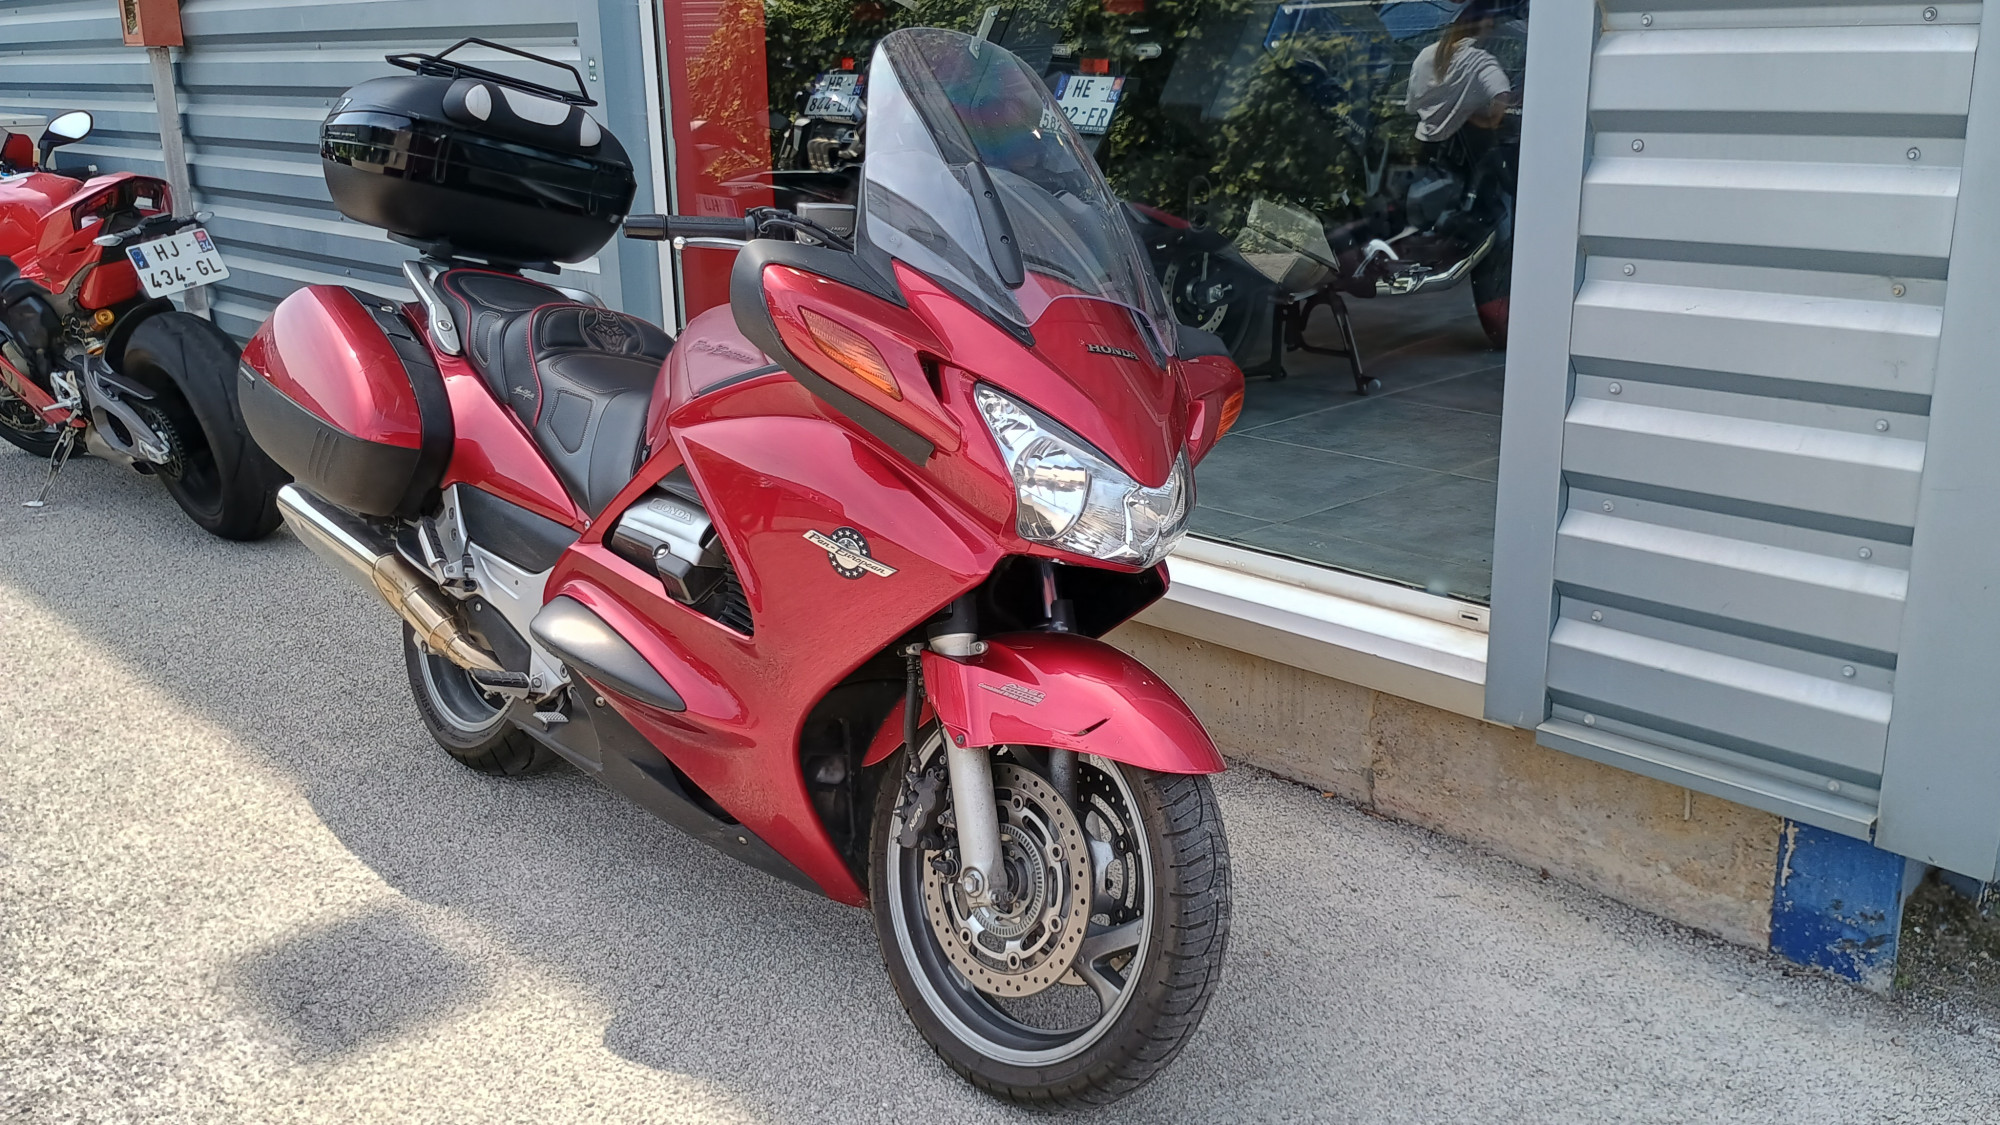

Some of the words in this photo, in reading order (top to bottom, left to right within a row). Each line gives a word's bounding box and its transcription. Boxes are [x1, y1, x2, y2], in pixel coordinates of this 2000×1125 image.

[200, 241, 212, 252] 34
[151, 258, 222, 289] 434-GL
[1086, 343, 1140, 361] HONDA
[654, 502, 693, 521] HONDA
